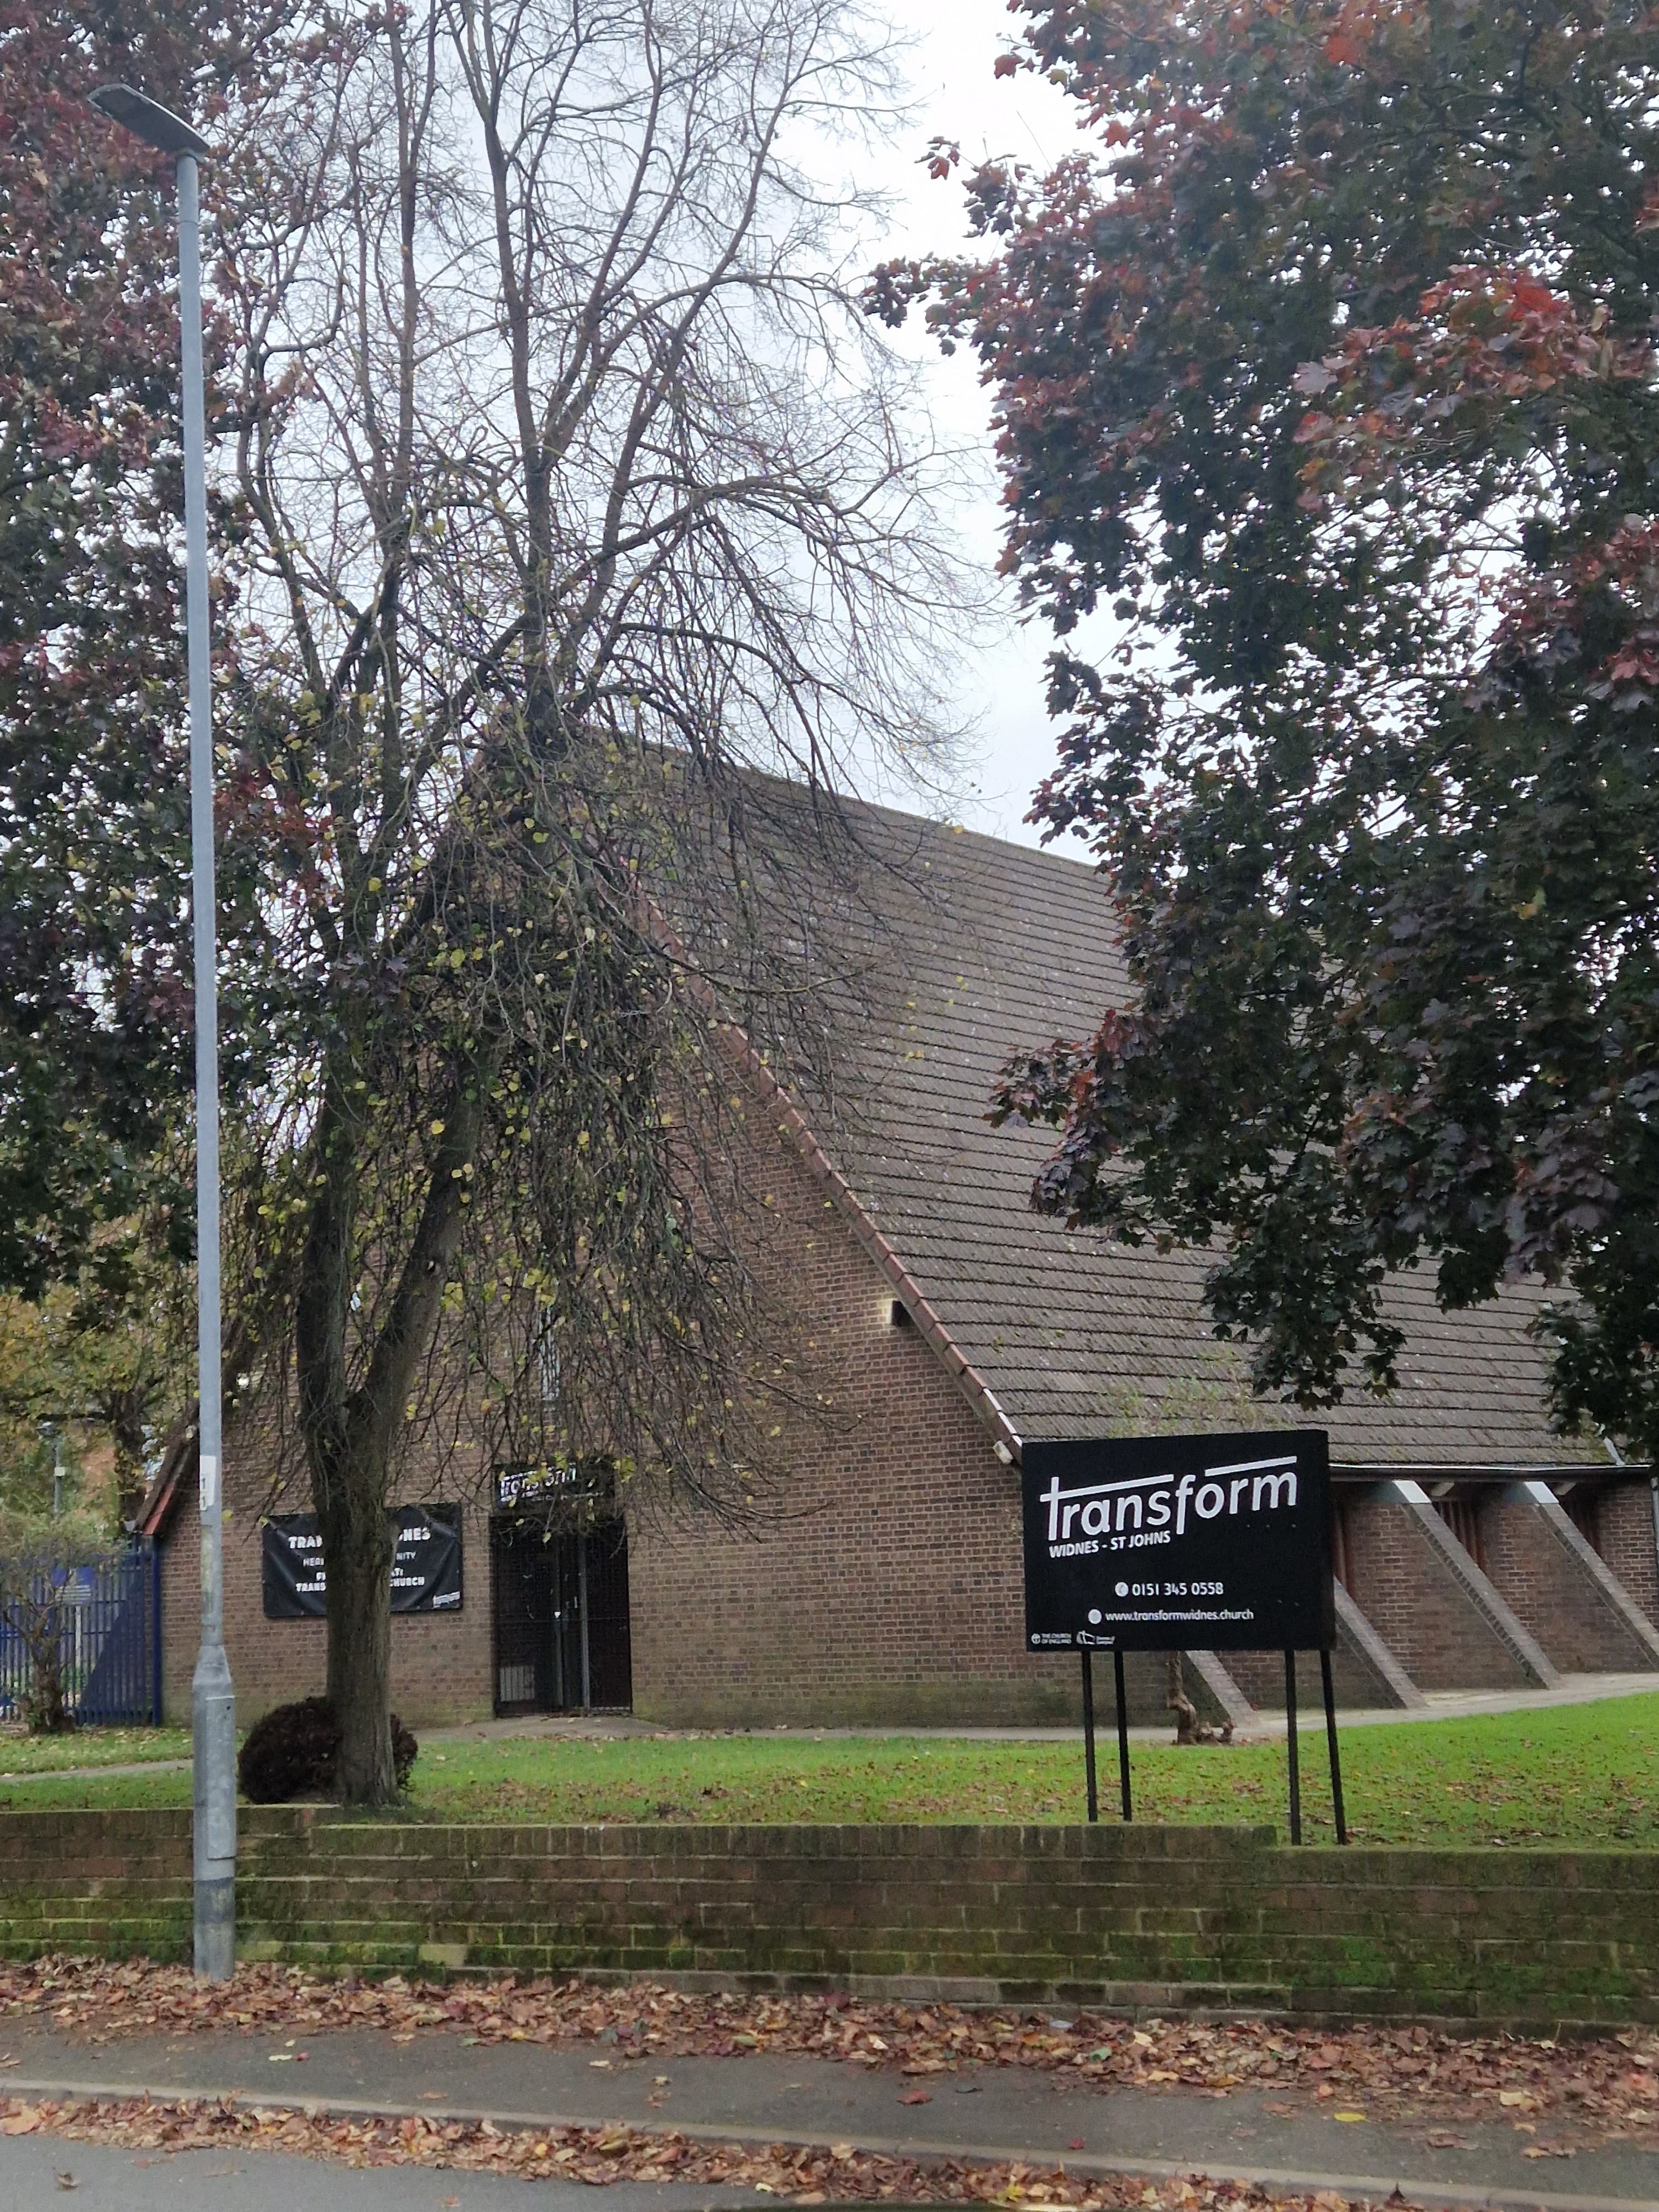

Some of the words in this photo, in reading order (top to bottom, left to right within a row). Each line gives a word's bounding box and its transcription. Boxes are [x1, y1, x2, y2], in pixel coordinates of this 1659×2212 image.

[1040, 1456, 1297, 1542] transform
[1049, 1540, 1099, 1558] WIDNES
[1110, 1536, 1126, 1550] ST
[1128, 1530, 1171, 1548] JOHNS
[1132, 1583, 1159, 1596] 0151
[1164, 1583, 1187, 1595] 345
[1191, 1582, 1224, 1595] 0558
[1105, 1608, 1254, 1621] www.transformwidnes.church
